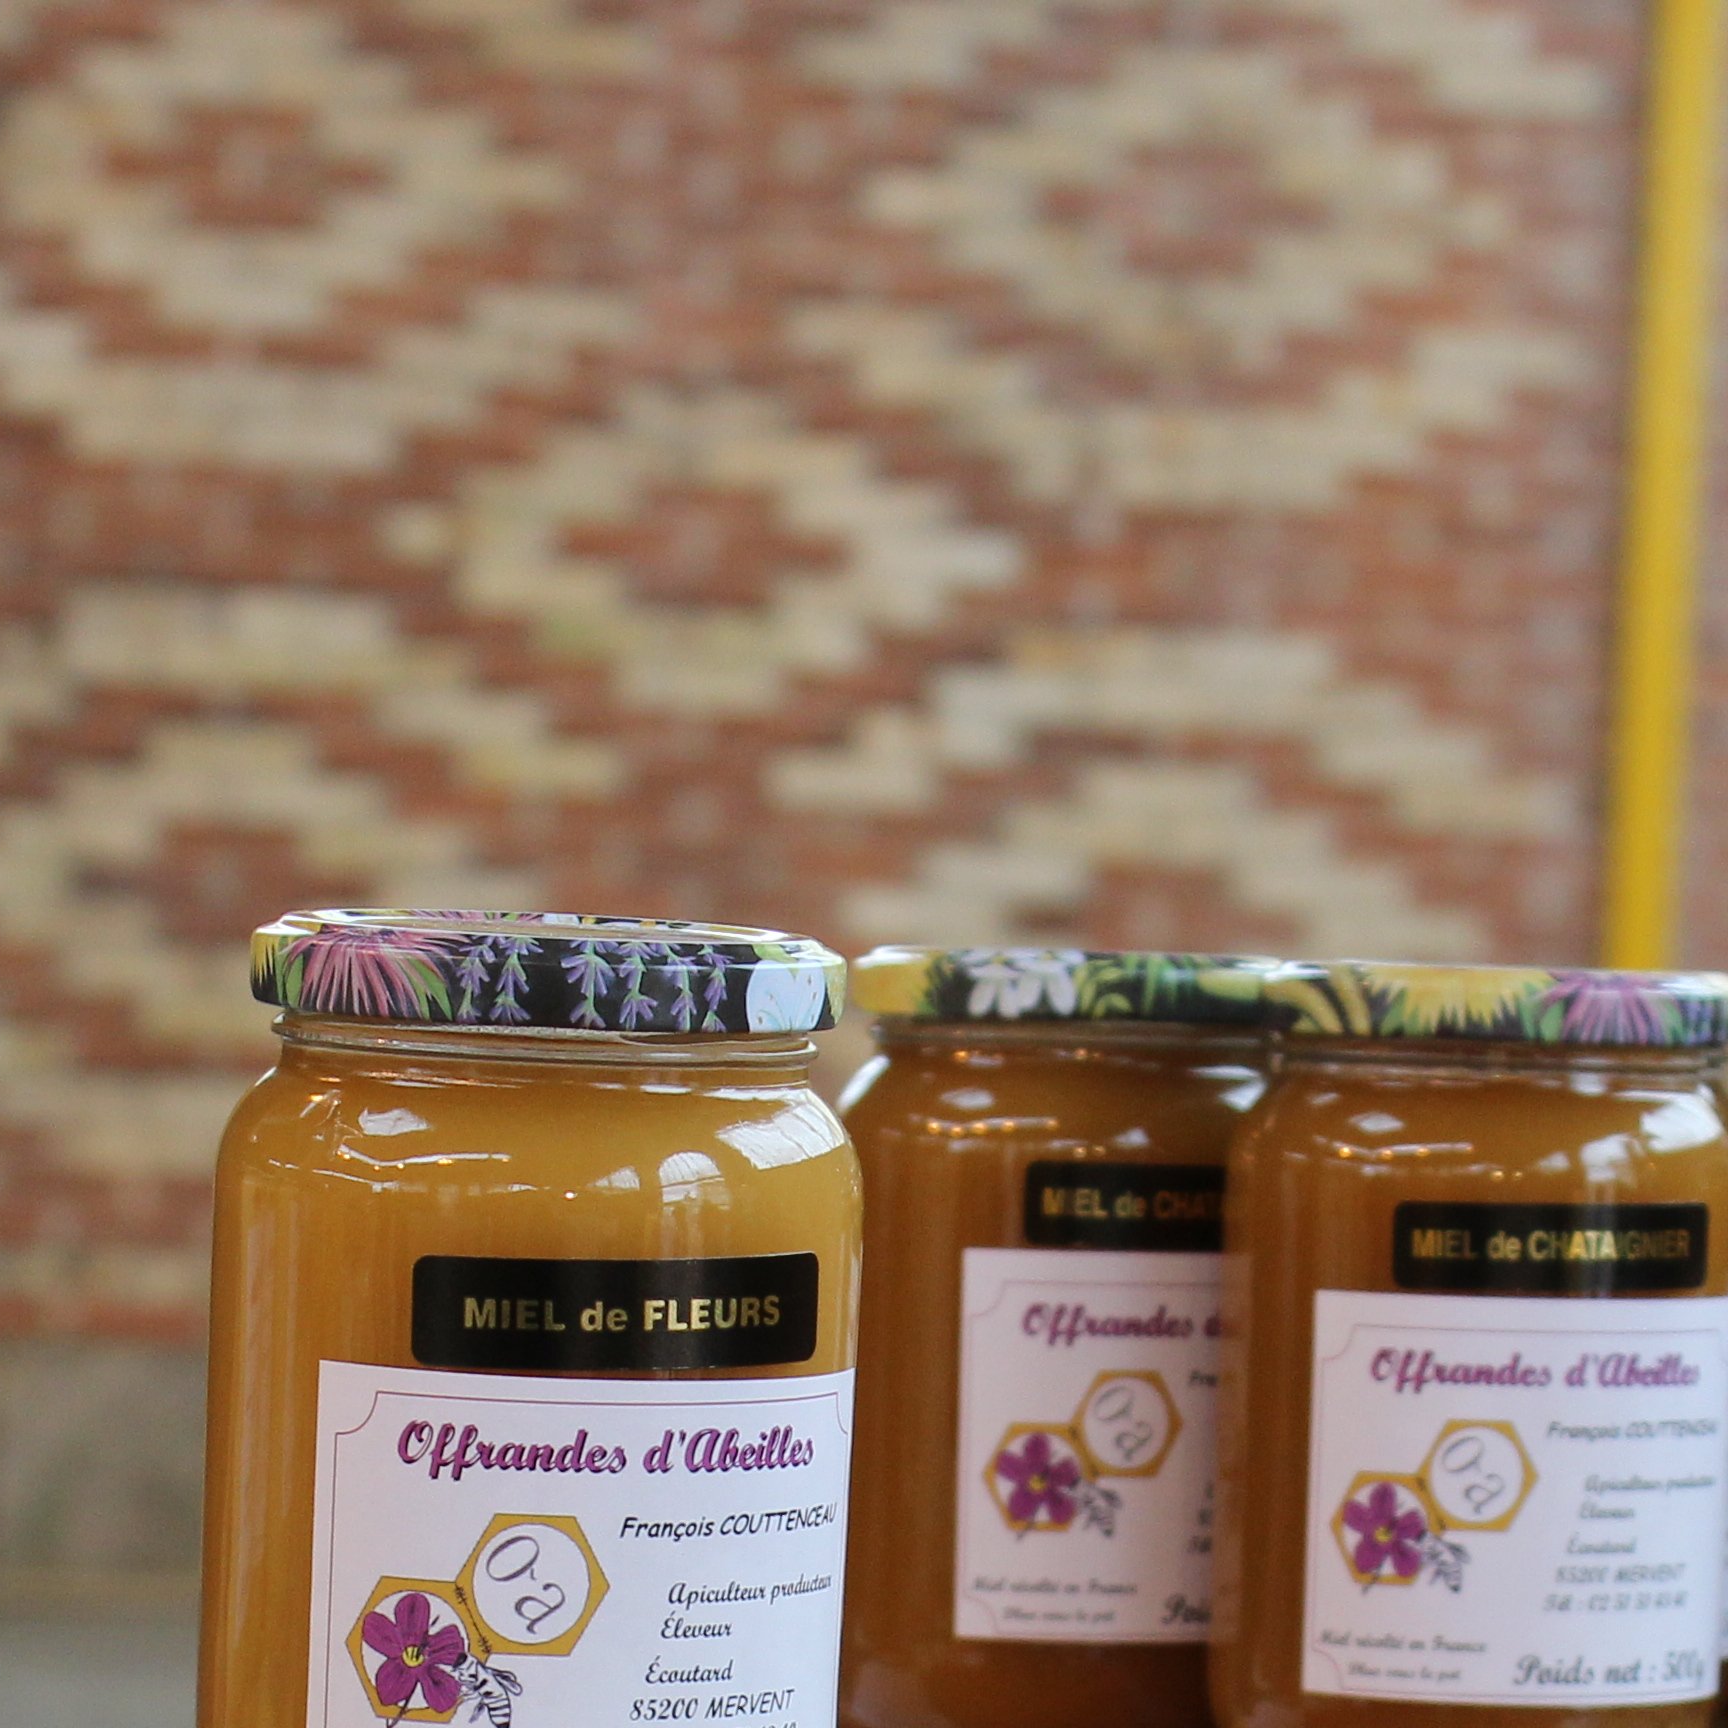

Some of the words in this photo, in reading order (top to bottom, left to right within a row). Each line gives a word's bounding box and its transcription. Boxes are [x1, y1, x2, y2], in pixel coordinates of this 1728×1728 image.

[1412, 1228, 1478, 1260] MIEL
[1486, 1229, 1522, 1261] de
[1527, 1228, 1691, 1262] CHATAIGNIER
[463, 1296, 566, 1331] MIEL
[580, 1299, 629, 1332] de
[643, 1295, 781, 1332] FLEURS
[1371, 1345, 1552, 1394] Offrandes
[397, 1418, 627, 1480] Offrandes
[642, 1423, 815, 1475] d'Abeilles
[619, 1516, 715, 1543] François
[719, 1502, 838, 1537] COUTTENCEAU
[667, 1580, 766, 1611] Apiculteur
[769, 1573, 832, 1605] producteur
[660, 1610, 733, 1640] Éleveur
[644, 1655, 734, 1685] Écoutard
[629, 1697, 700, 1721] 85200
[704, 1688, 796, 1720] MERVENT
